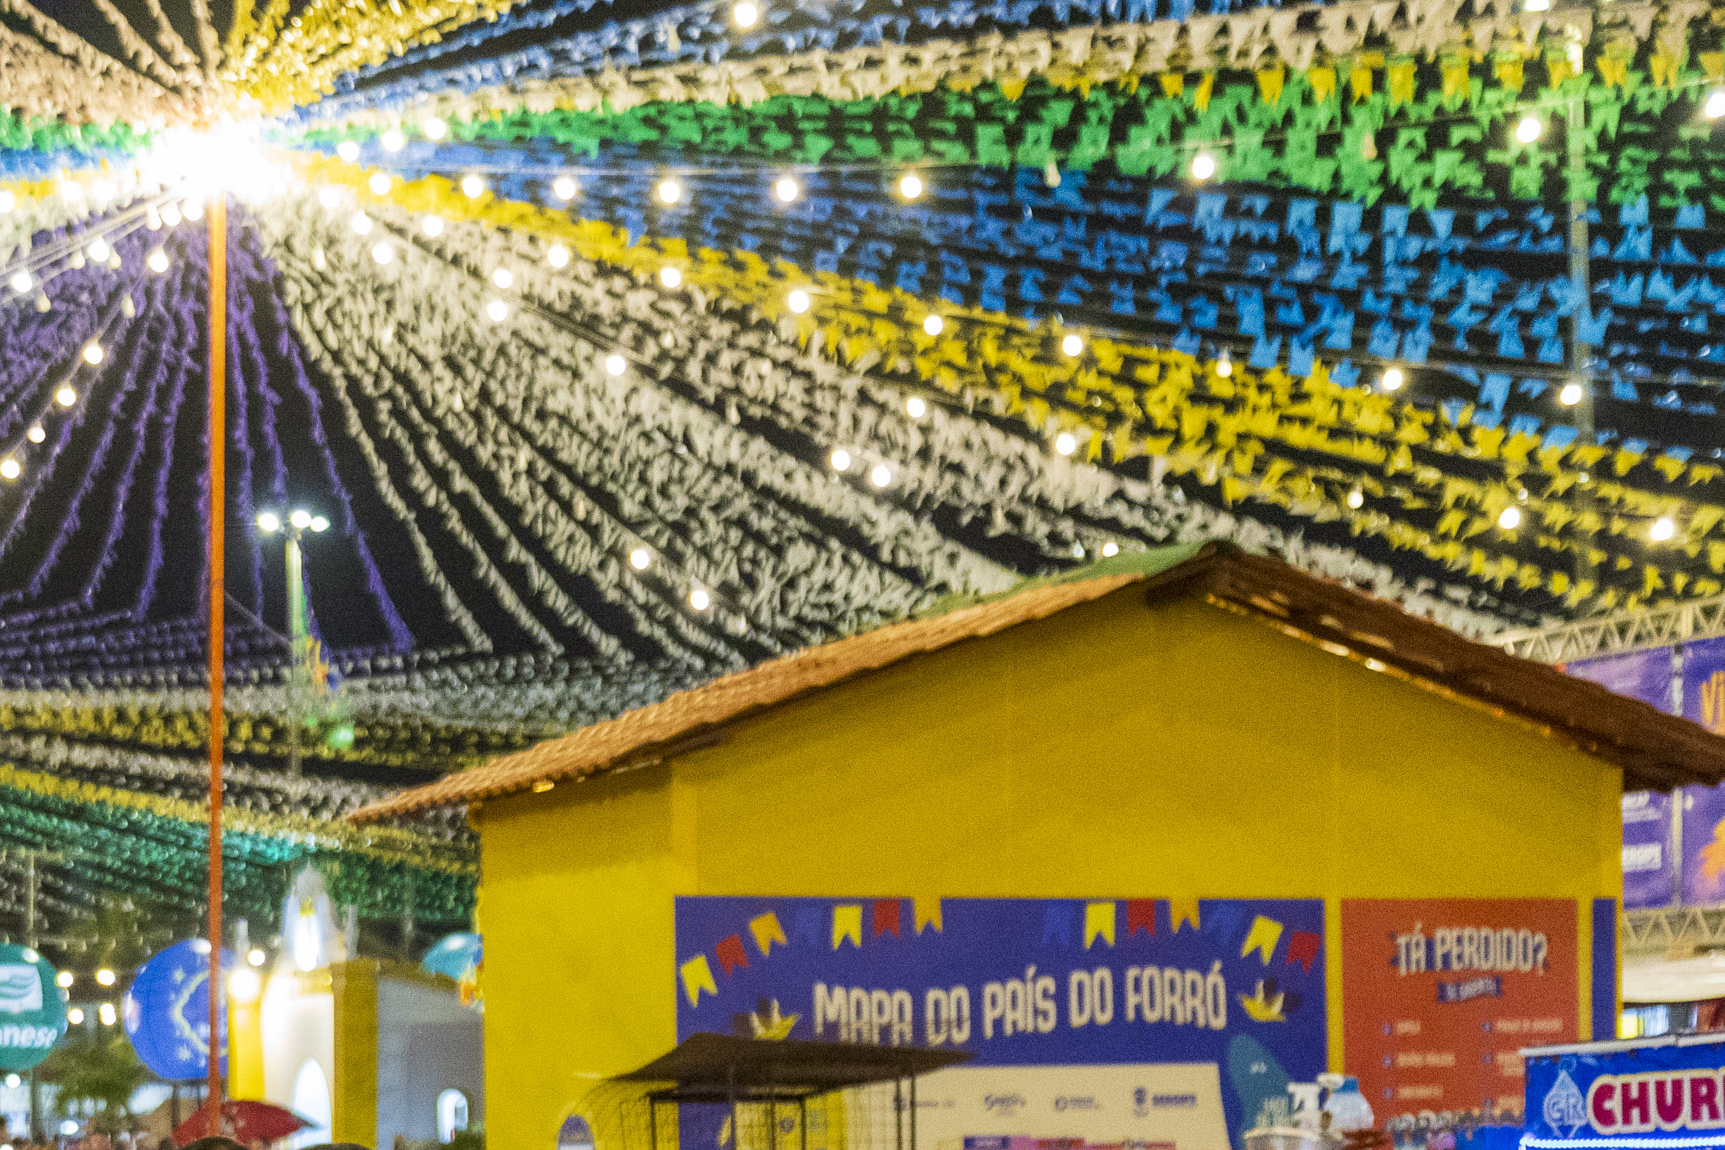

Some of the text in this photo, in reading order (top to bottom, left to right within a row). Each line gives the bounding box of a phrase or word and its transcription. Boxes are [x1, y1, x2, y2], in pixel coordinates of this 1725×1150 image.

[1396, 922, 1548, 976] TÁ PERDIDO?
[815, 960, 1227, 1048] MAPA DO PAÍS DO FORRÓ
[1590, 1073, 1725, 1130] CHUR
